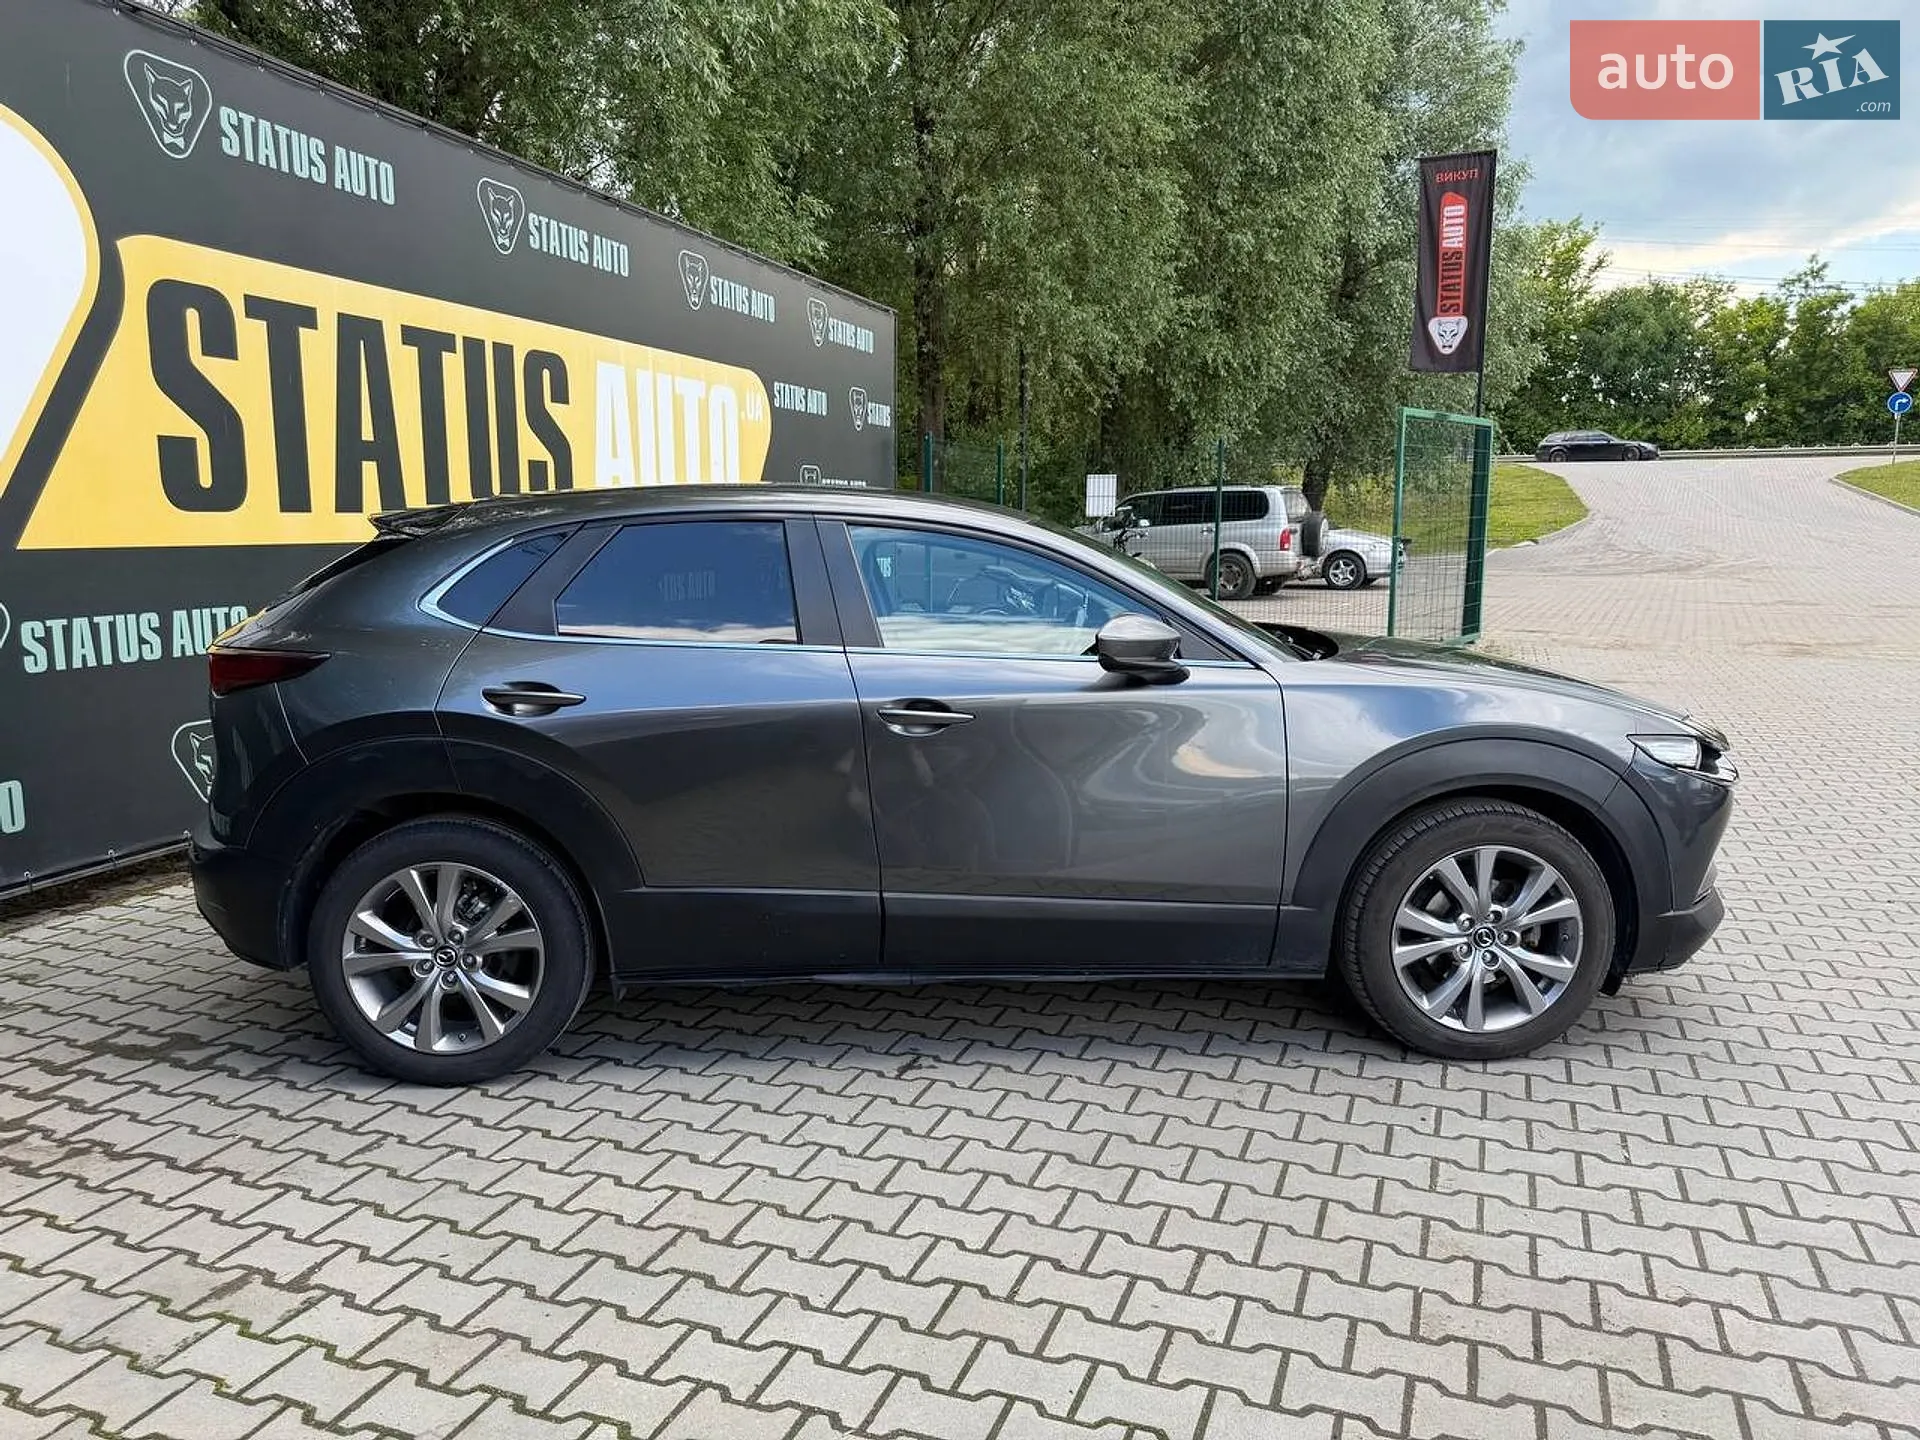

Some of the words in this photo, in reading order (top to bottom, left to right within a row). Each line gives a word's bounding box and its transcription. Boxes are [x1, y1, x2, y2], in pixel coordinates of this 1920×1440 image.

[218, 106, 327, 185] STATUS
[334, 145, 396, 206] AUTO
[1435, 168, 1478, 183] ВИКУП
[528, 212, 590, 265] STATUS
[592, 233, 630, 278] AUTO
[1441, 204, 1465, 248] AUTO
[710, 275, 750, 315] STATUS
[750, 289, 776, 323] AUTO
[1440, 250, 1463, 313] STATUS
[828, 317, 856, 349] STATUS
[856, 328, 874, 354] AUTO
[146, 277, 574, 513] STATUS
[594, 360, 740, 488] AUTO
[773, 381, 807, 412] STATUS
[807, 387, 828, 416] AUTO
[20, 611, 163, 674] STATUS
